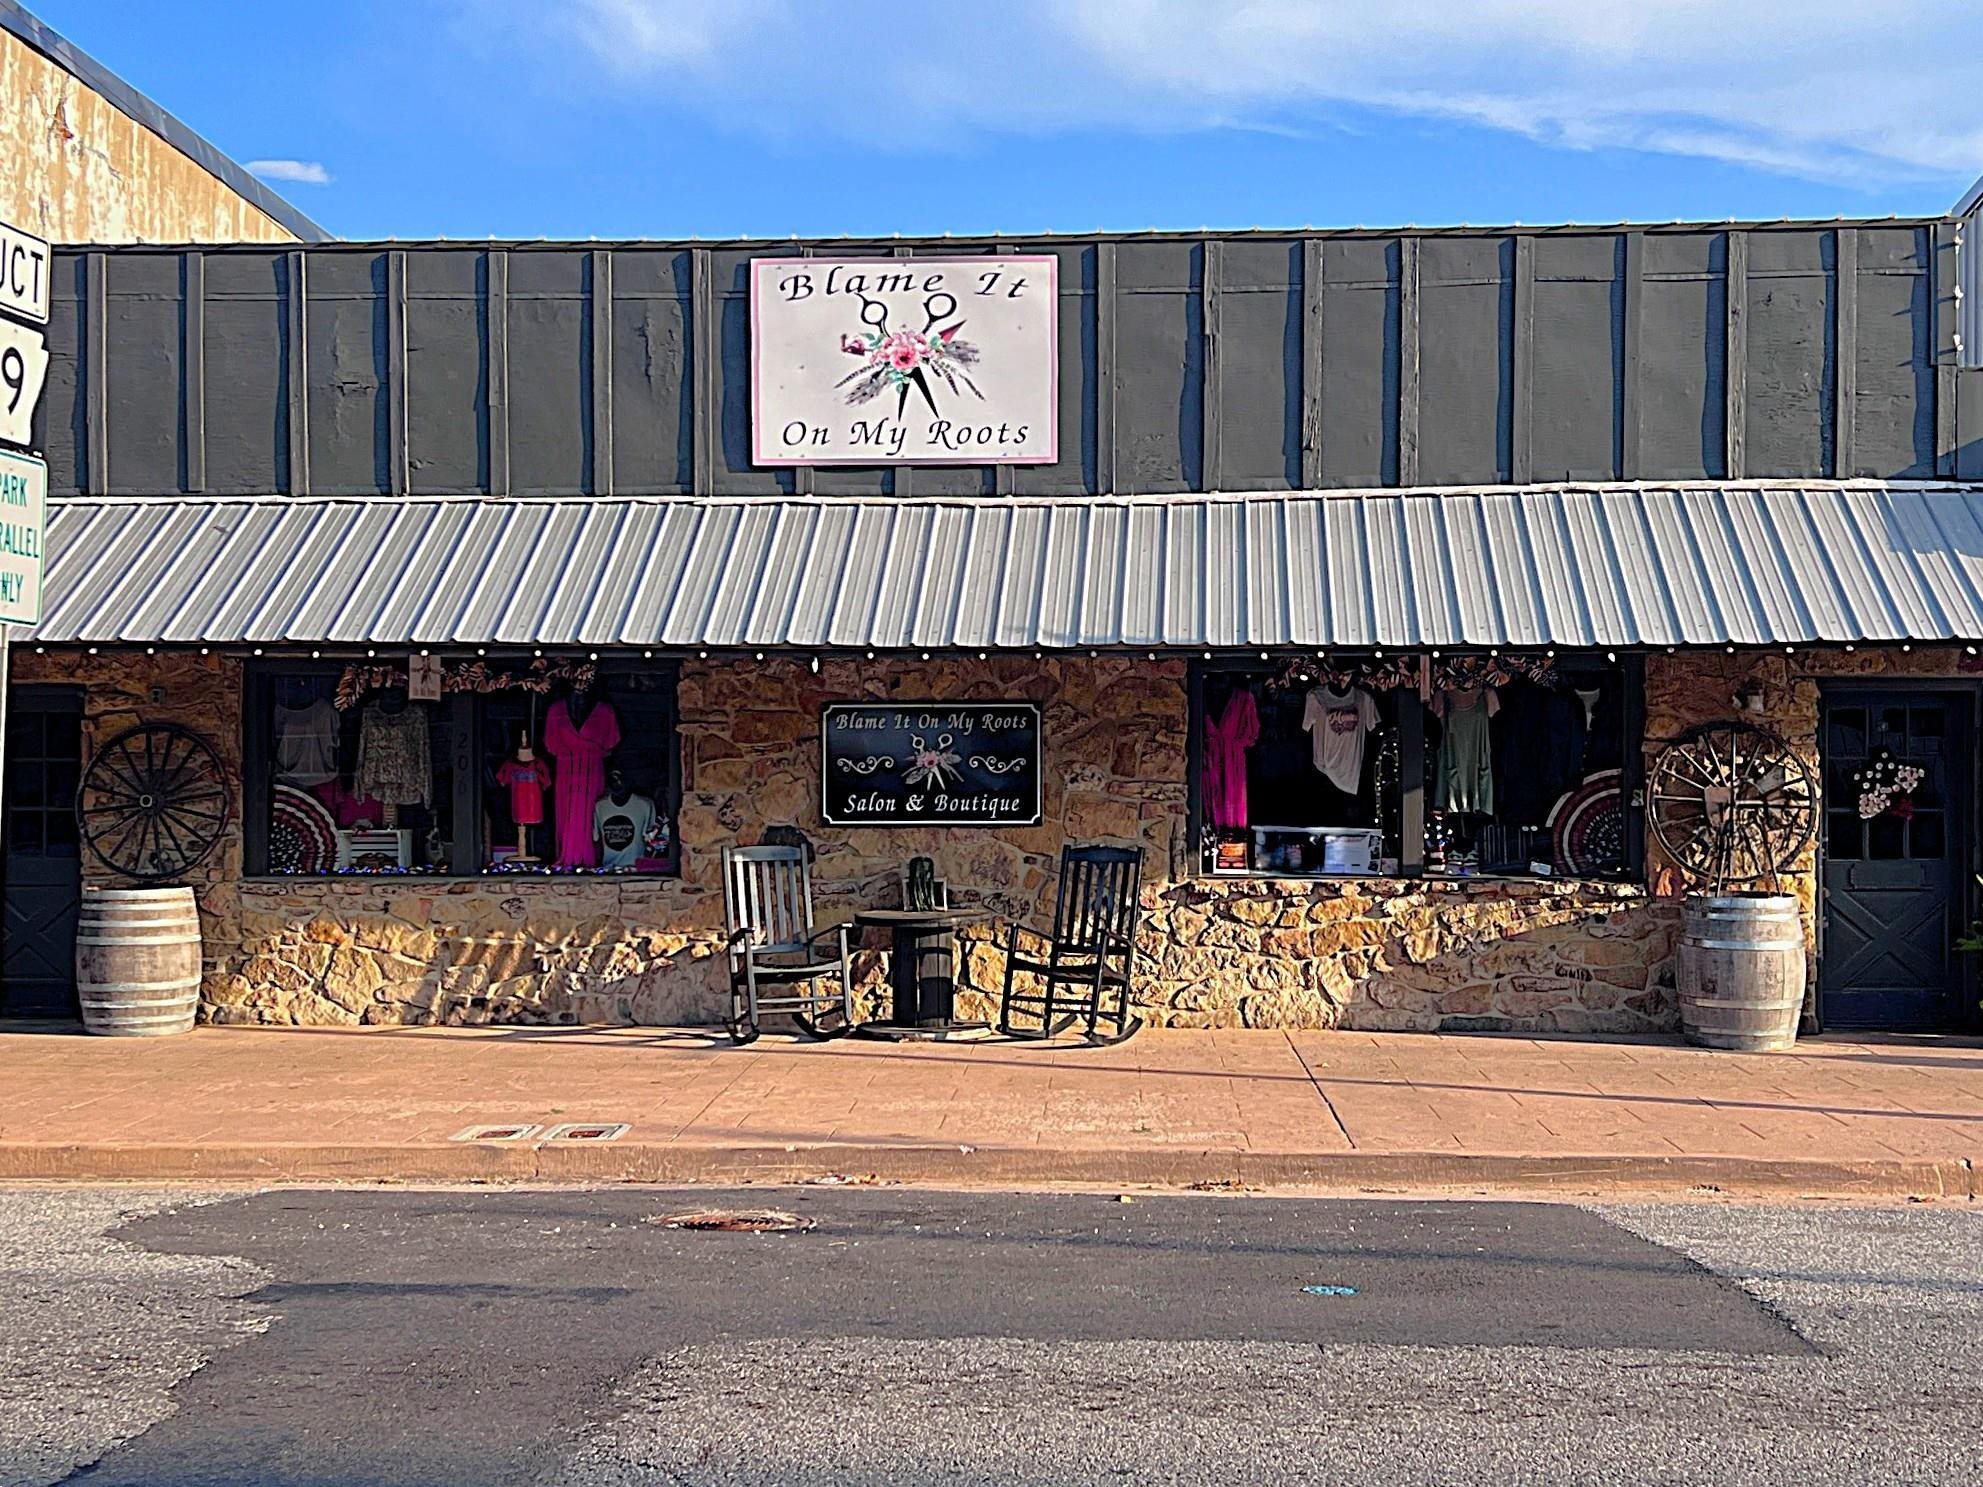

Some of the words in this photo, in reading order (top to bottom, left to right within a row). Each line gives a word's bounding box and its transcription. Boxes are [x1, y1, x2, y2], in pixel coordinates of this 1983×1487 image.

[779, 266, 945, 301] Blame
[974, 271, 1029, 298] It
[2, 346, 24, 416] 9
[782, 421, 831, 446] On
[849, 416, 909, 456] My
[926, 419, 1029, 451] Roots
[0, 473, 27, 507] ARK
[836, 712, 886, 730] Blame
[894, 714, 910, 730] It
[918, 714, 939, 729] On
[948, 712, 974, 735] My
[982, 713, 1027, 732] Roots
[844, 792, 896, 814] Salon
[905, 794, 924, 811] &
[934, 793, 1020, 819] Boutique
